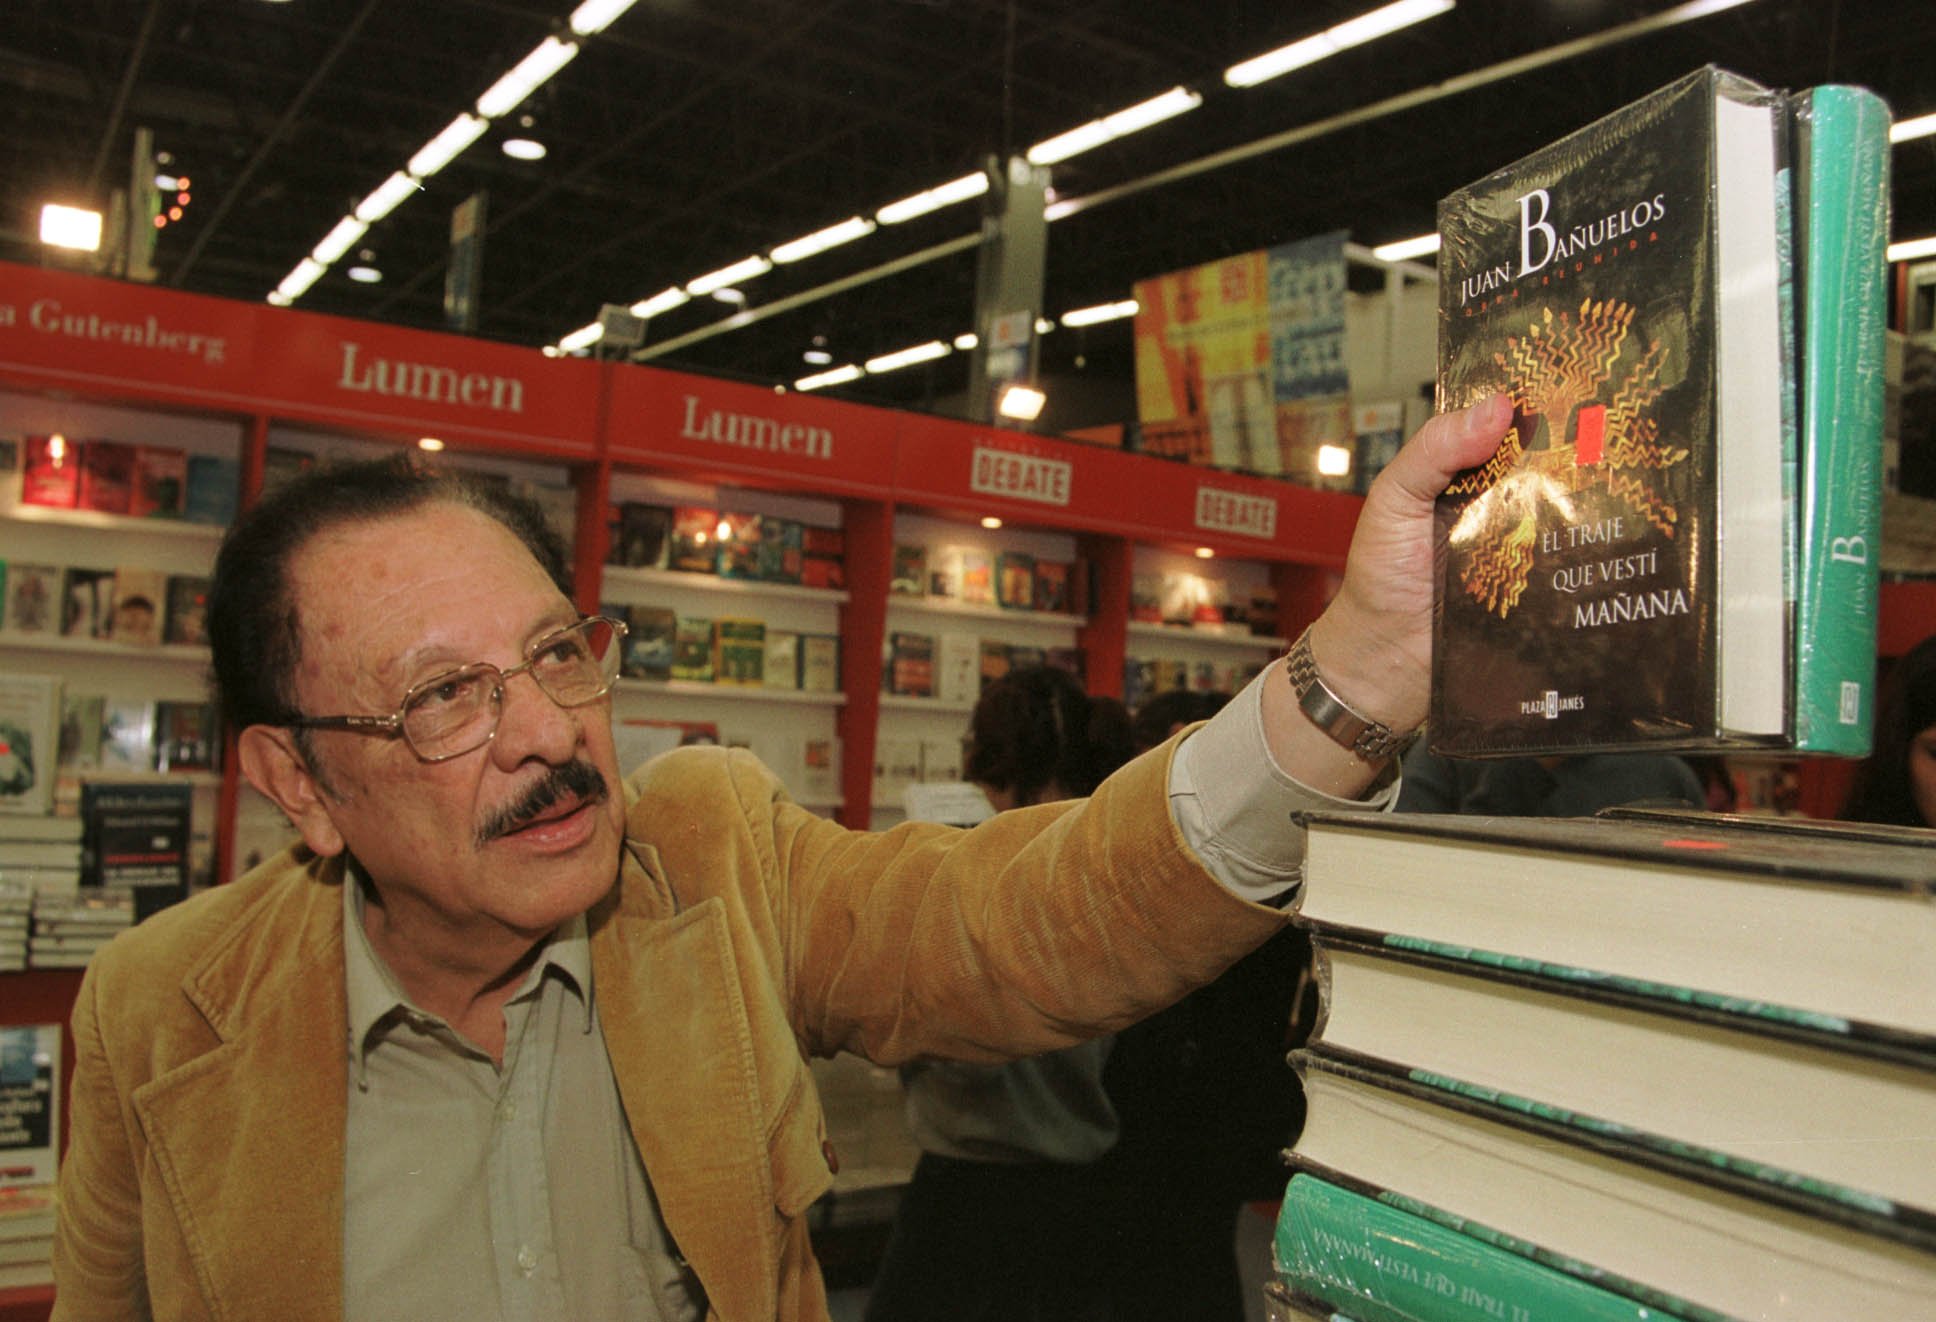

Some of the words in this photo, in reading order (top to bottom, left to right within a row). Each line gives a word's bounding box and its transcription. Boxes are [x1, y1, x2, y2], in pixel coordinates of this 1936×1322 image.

[1461, 261, 1510, 307] JUAN
[1516, 188, 1666, 279] BAÑUELOS
[29, 298, 226, 364] Gutenberg
[339, 341, 525, 413] Lumen
[681, 395, 833, 460] Lumen
[976, 452, 1065, 501] DEBATE
[1200, 491, 1272, 535] DEBATE
[1542, 532, 1562, 553] EL
[1567, 516, 1624, 547] TRAJE
[1553, 564, 1594, 594] QUE
[1600, 547, 1657, 583] VESTÍ
[1574, 588, 1689, 629] MAÑANA
[1521, 700, 1546, 715] PLAZA
